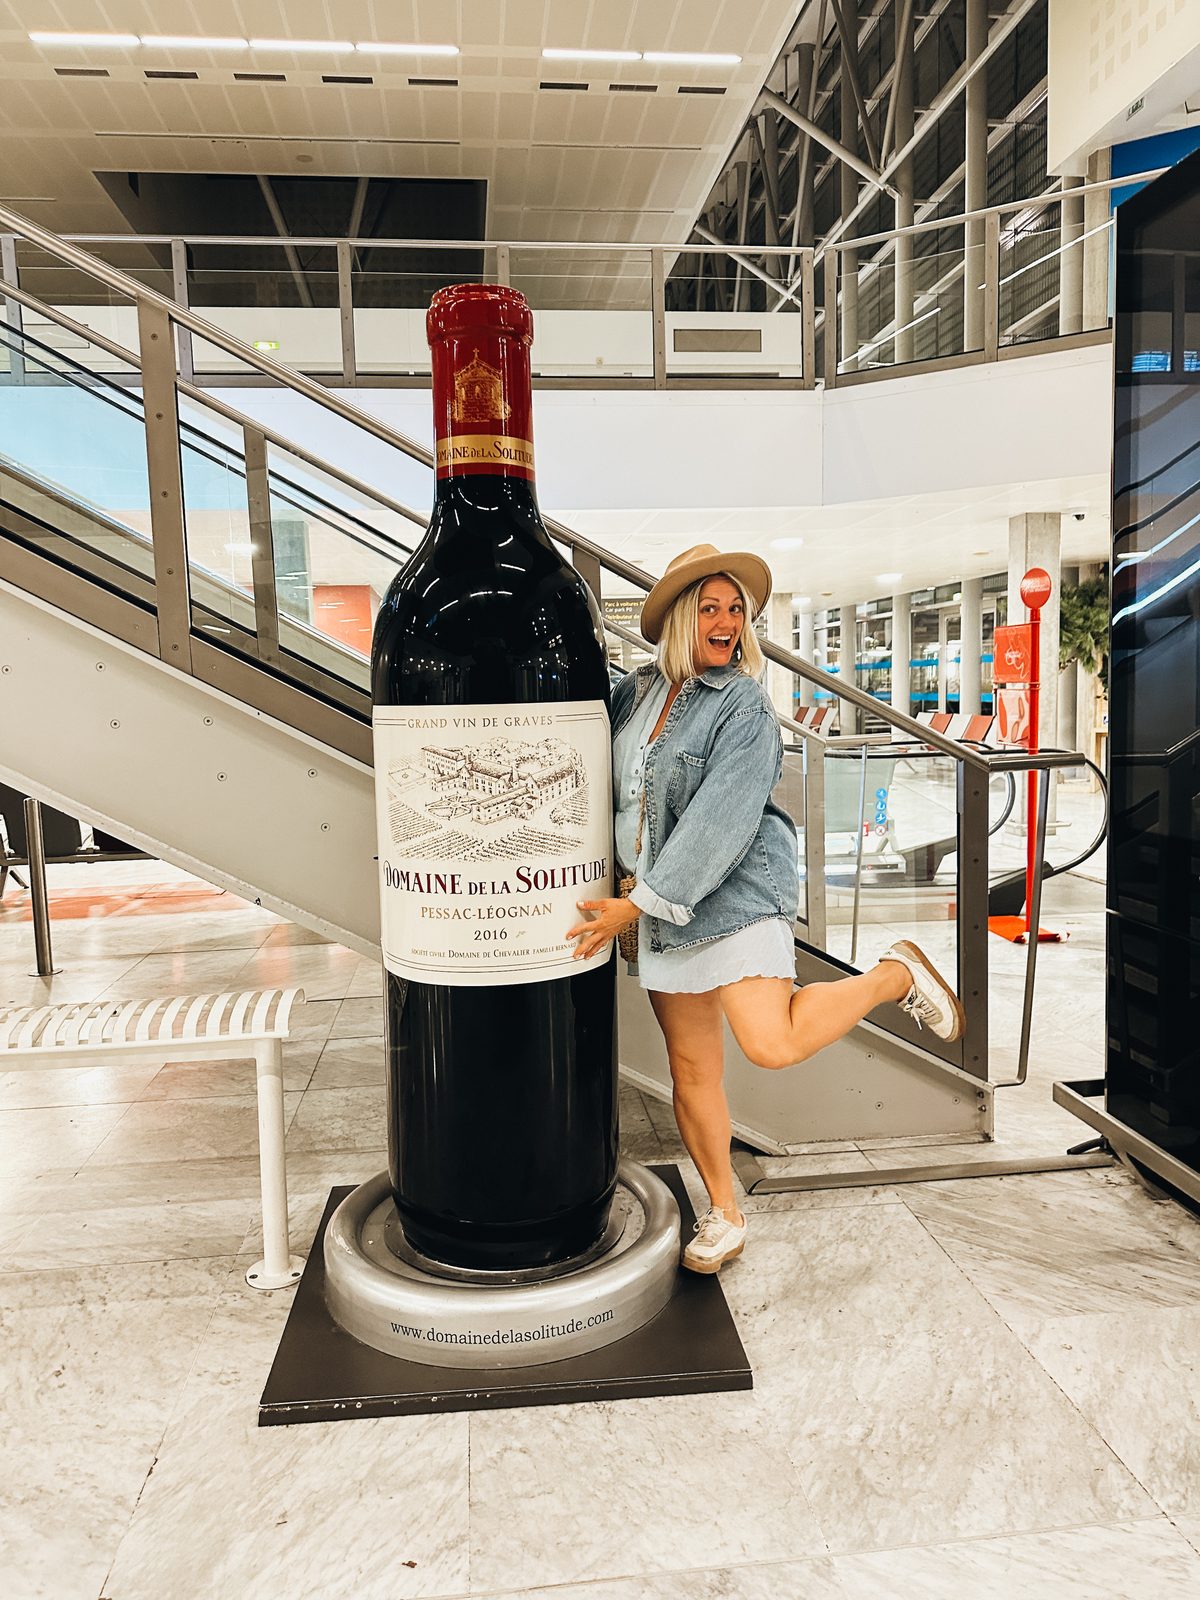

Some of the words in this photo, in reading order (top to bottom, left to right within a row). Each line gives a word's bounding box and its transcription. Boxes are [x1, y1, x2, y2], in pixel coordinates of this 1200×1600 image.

[437, 446, 469, 463] OMAINE
[493, 441, 533, 465] SOLITUDE
[407, 718, 448, 729] GRAND
[453, 717, 477, 729] VIN
[482, 716, 499, 728] DE
[504, 715, 553, 727] GRAVES
[383, 859, 463, 895] DOMAINE
[468, 880, 487, 896] DE
[491, 880, 512, 895] LA
[515, 857, 608, 894] SOLITUDE
[420, 902, 553, 920] PESSAC-LÉOGNAN
[473, 928, 508, 941] 2016
[448, 949, 480, 959] DOMAINE
[482, 951, 491, 959] DE
[493, 948, 530, 958] CHEVALIER
[532, 946, 554, 955] FAMILLE
[555, 941, 577, 951] BERNARD
[390, 1308, 614, 1345] www.domainedelasolitude.com
